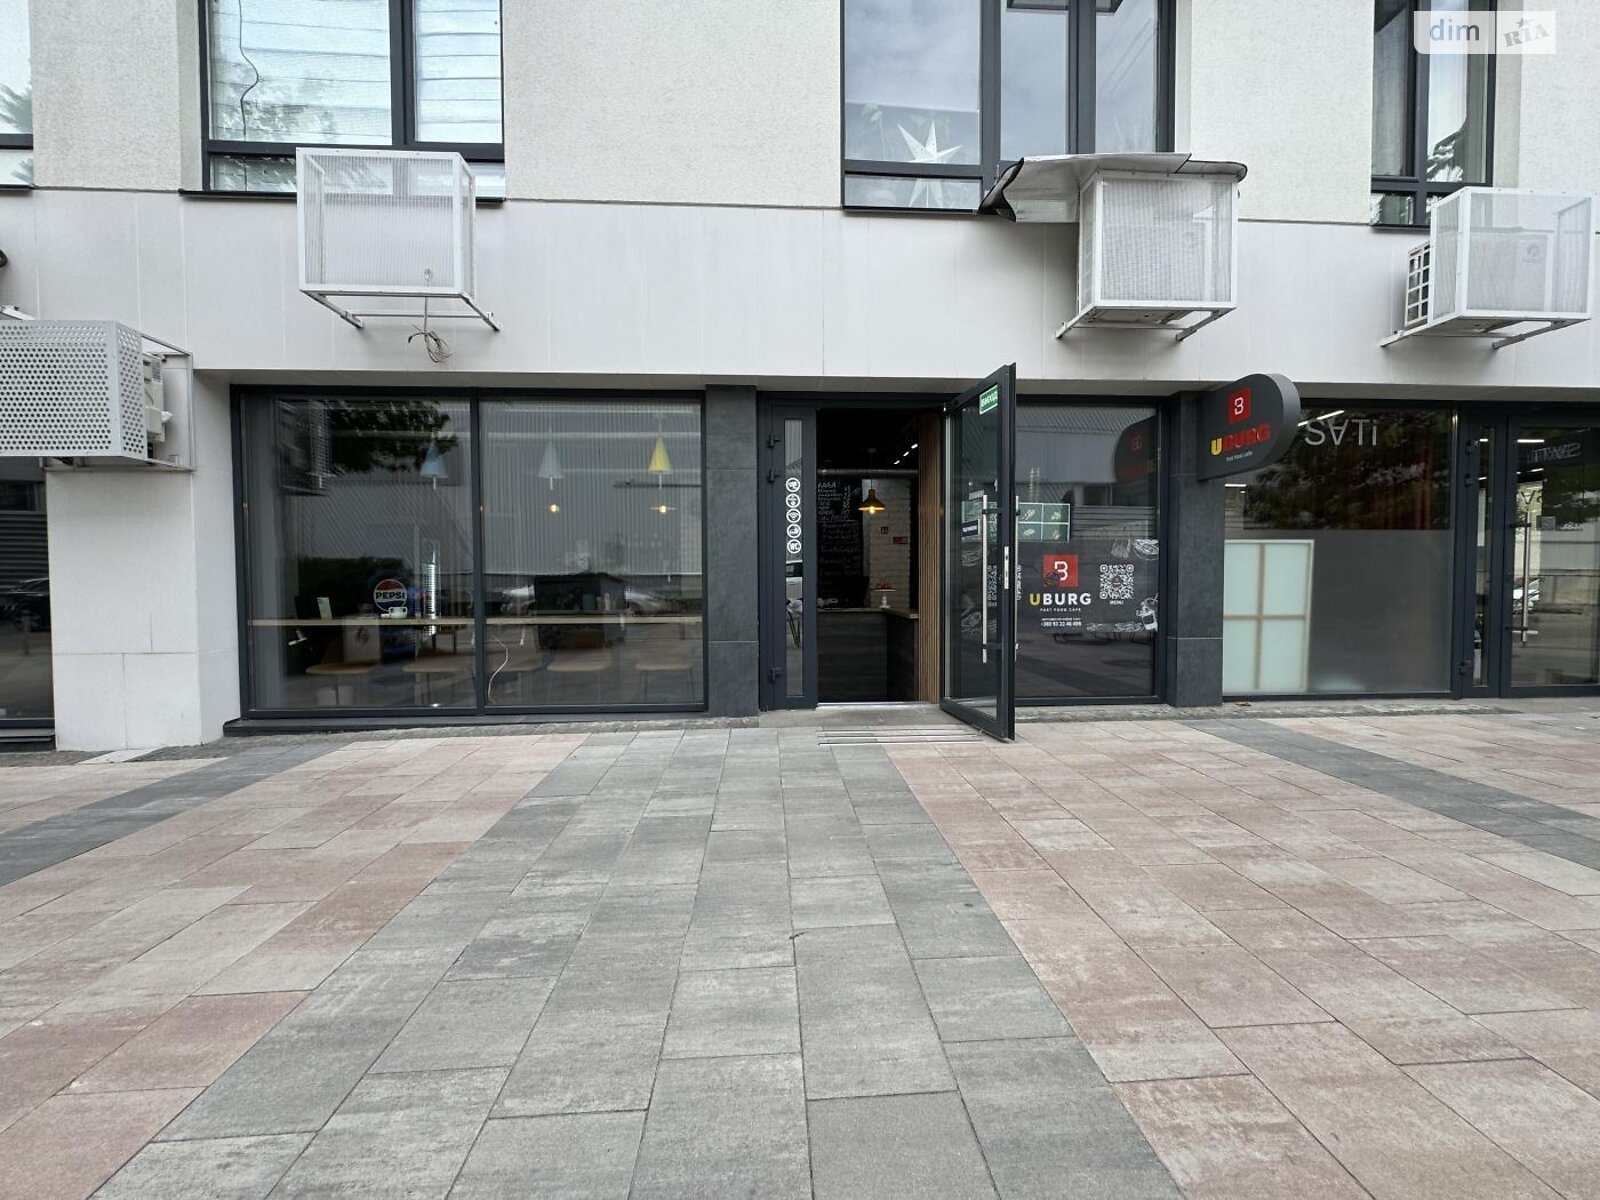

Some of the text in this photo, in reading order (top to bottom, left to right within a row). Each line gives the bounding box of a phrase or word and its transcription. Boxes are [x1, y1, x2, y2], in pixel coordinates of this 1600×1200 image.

[1210, 423, 1271, 456] UBURG
[375, 591, 405, 600] PEPSI
[1029, 592, 1092, 606] UBURG
